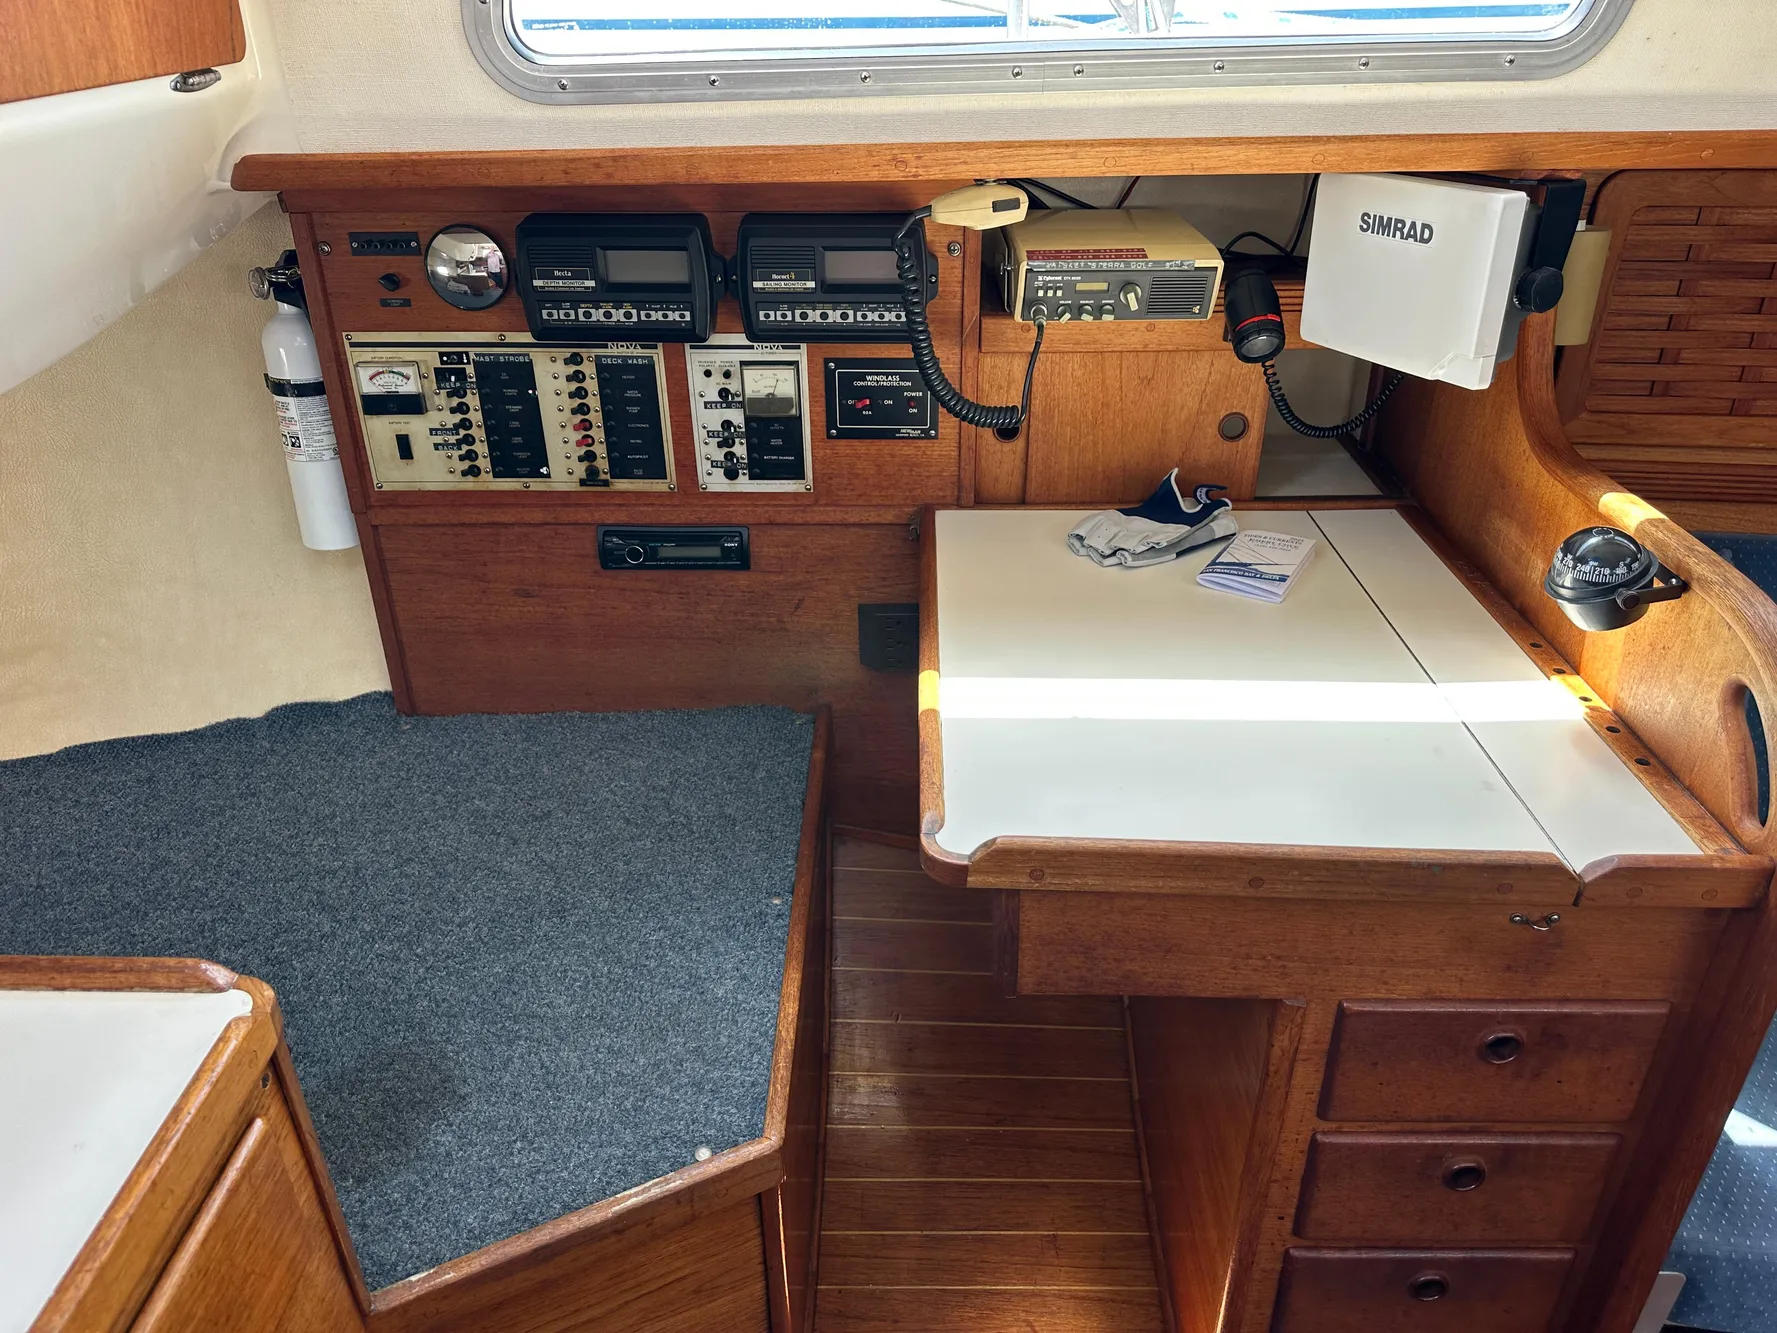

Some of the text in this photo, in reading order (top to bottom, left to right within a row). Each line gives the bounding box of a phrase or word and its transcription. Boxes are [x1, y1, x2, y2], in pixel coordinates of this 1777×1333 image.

[1359, 212, 1434, 245] SIMRAD
[608, 342, 642, 350] NOVA
[1562, 557, 1573, 567] 270
[1576, 562, 1590, 573] 240
[1595, 567, 1609, 575] 210
